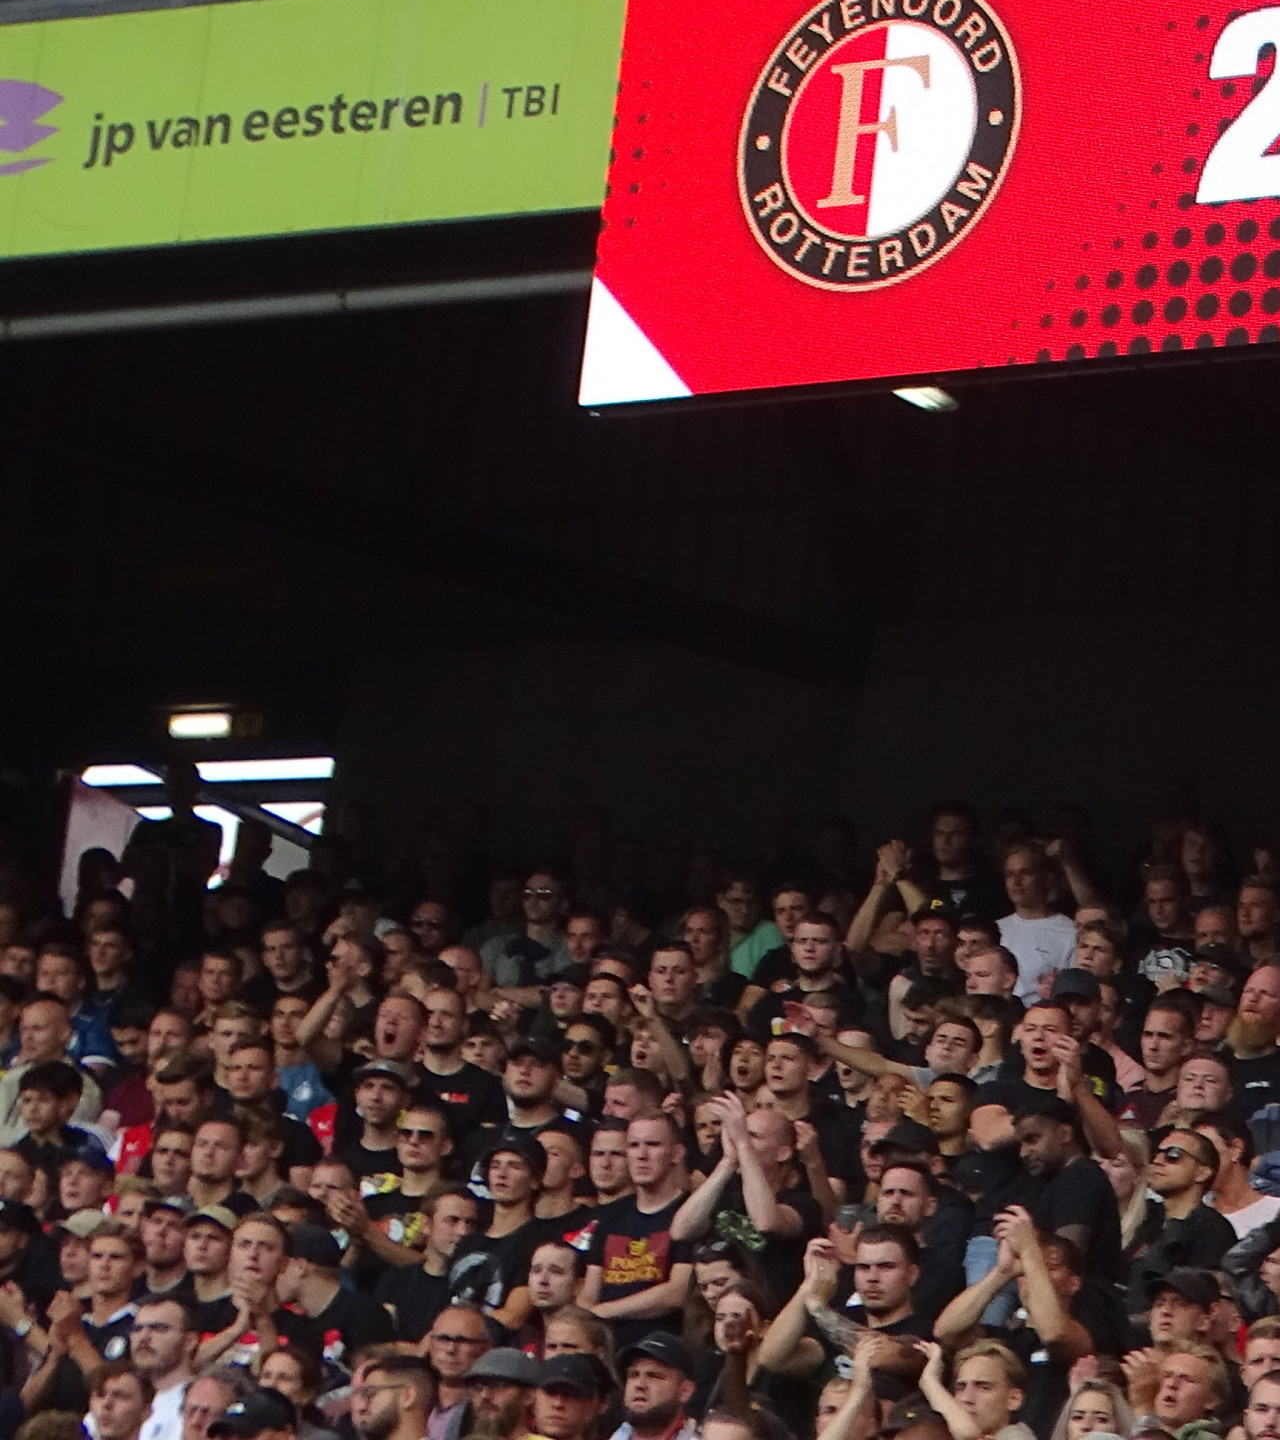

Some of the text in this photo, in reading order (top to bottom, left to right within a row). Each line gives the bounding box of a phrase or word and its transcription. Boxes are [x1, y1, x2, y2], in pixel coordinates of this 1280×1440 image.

[82, 82, 561, 169] jp van eesteren TBI
[752, 160, 993, 278] ROTTERDAM
